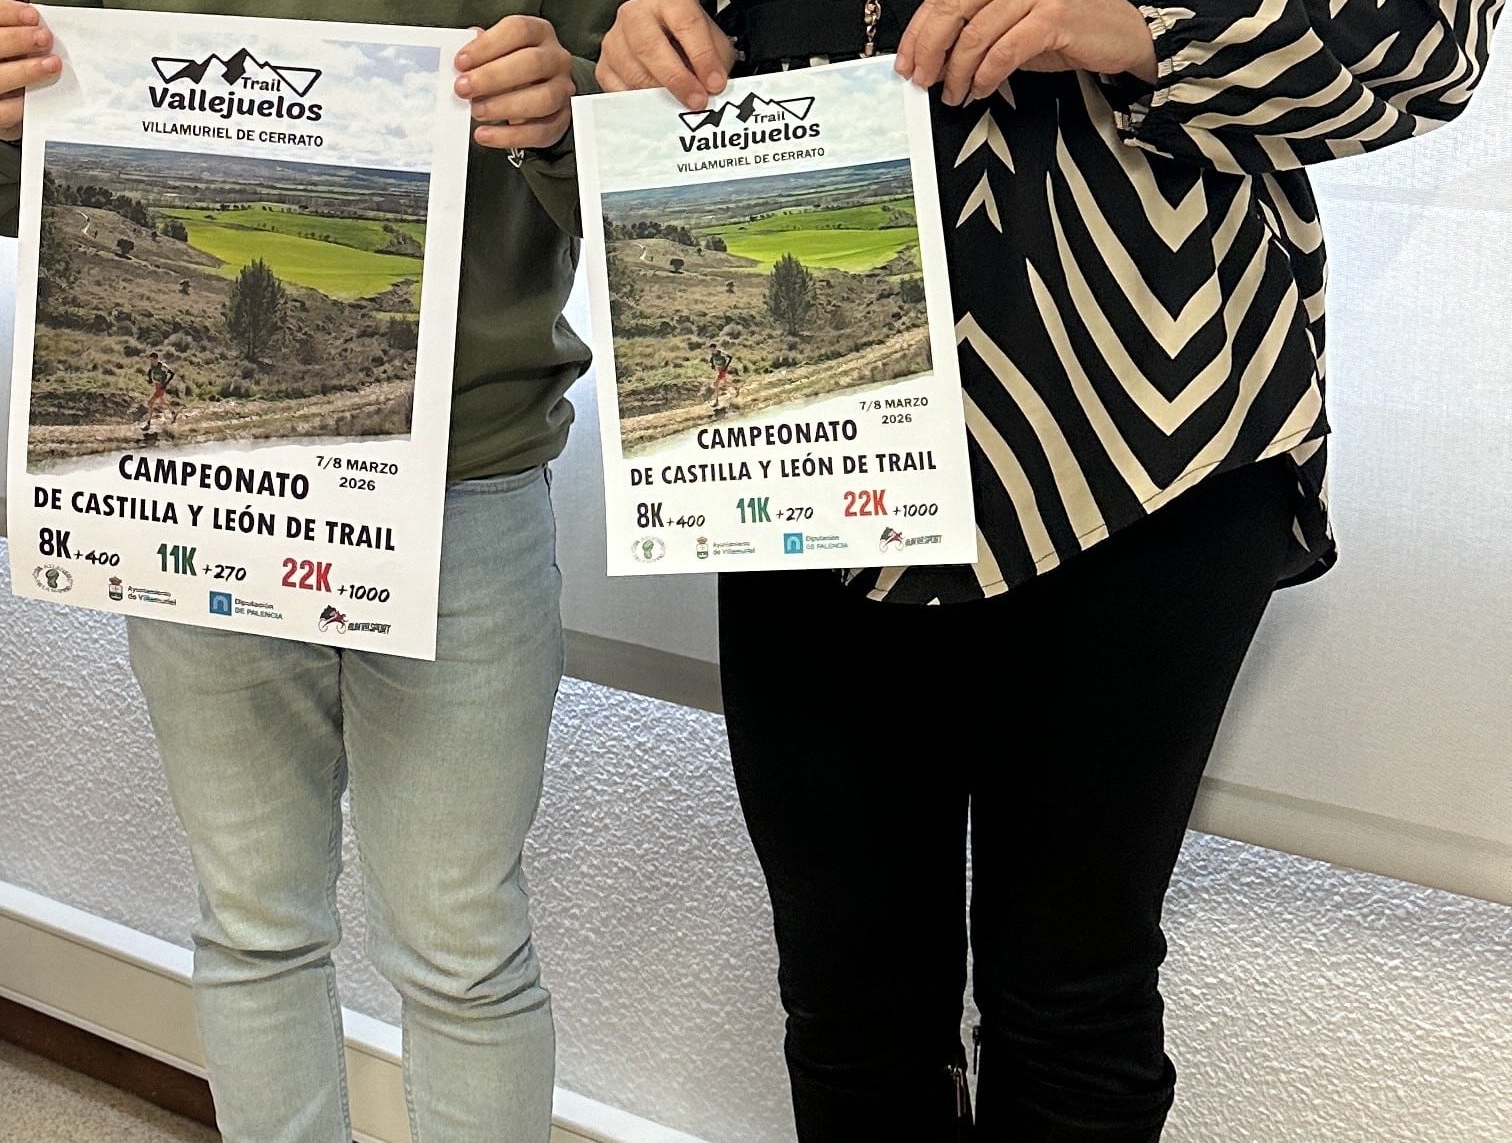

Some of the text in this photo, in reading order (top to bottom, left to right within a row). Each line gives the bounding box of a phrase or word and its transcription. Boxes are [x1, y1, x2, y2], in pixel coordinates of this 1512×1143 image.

[241, 76, 281, 92] Trail
[148, 85, 323, 121] Vallejuelos
[752, 111, 786, 124] Trail
[142, 121, 324, 148] VILLAMURIEL DE CERRATO
[679, 122, 820, 153] Vallejuelos
[677, 147, 825, 173] VILLAMURIEL DE CERRATO
[859, 396, 929, 411] 7/8 MARZO
[881, 413, 913, 425] 2026
[697, 419, 858, 450] CAMPEONATO
[118, 454, 310, 500] CAMPEONATO
[316, 455, 399, 476] 7/8 MARZO
[631, 451, 937, 486] DE CASTILLA Y LEÓN DE TRAIL
[338, 477, 376, 491] 2026
[736, 496, 814, 524] 11K +270
[843, 489, 939, 518] 22K +1000
[34, 486, 396, 551] DE CASTILLA Y LEÓN DE TRAIL
[156, 543, 247, 582] 11K +270
[281, 557, 391, 604] 22K +1000
